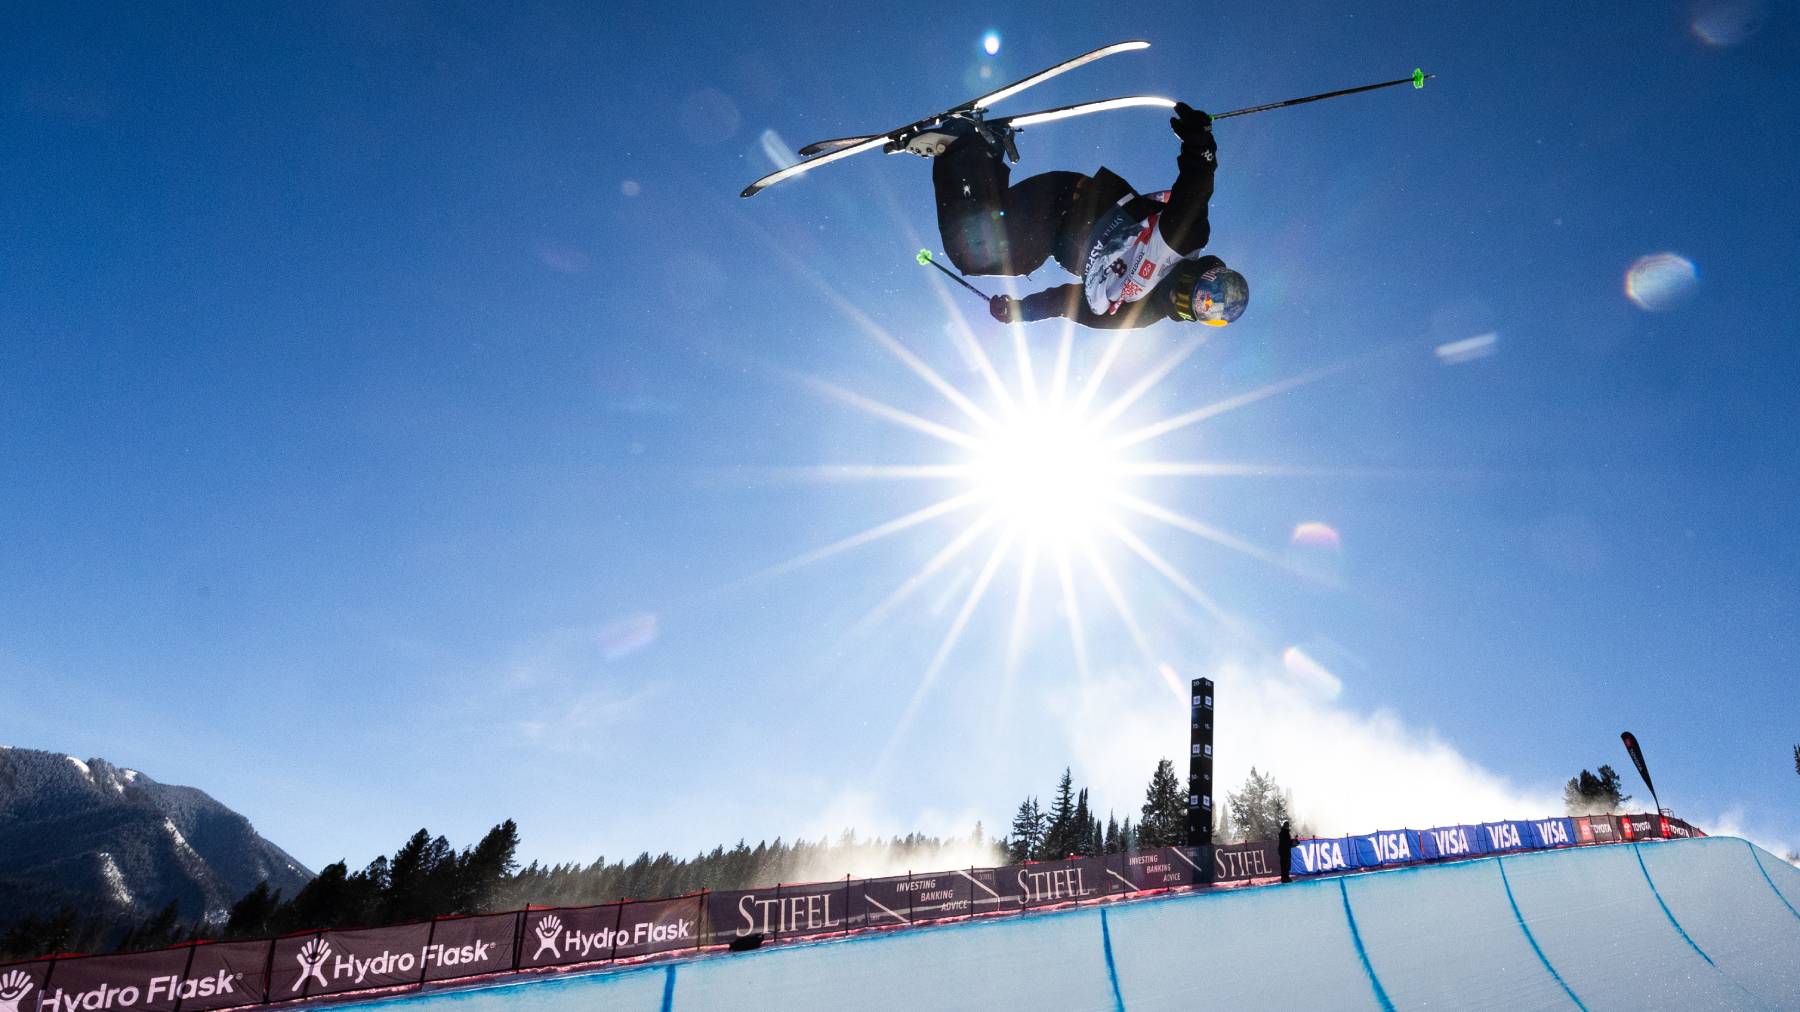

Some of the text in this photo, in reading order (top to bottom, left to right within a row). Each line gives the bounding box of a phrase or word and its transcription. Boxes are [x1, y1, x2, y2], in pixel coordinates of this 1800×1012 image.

[1486, 823, 1522, 851] VISA
[1536, 820, 1569, 846] VISA
[1590, 823, 1612, 833] TOYOTA
[1632, 821, 1652, 832] TOYOTA
[1669, 824, 1690, 838] TOYOTA
[1368, 833, 1411, 863] VISA
[1434, 828, 1470, 856] VISA
[1129, 854, 1158, 866] INVESTING
[1146, 863, 1171, 874] BANKING
[1215, 848, 1273, 879] STIFEL
[1297, 841, 1346, 872] VISA
[896, 879, 936, 893] INVESTING
[1017, 868, 1090, 905] STIFEL
[1163, 872, 1181, 882] ADVICE
[920, 890, 954, 902] BANKING
[941, 900, 968, 912] ADVICE
[736, 893, 840, 937] STIFEL
[565, 918, 690, 957] Hydro Flask
[333, 939, 489, 984] Hydro Flask
[39, 969, 236, 1012] Hydro Flask
